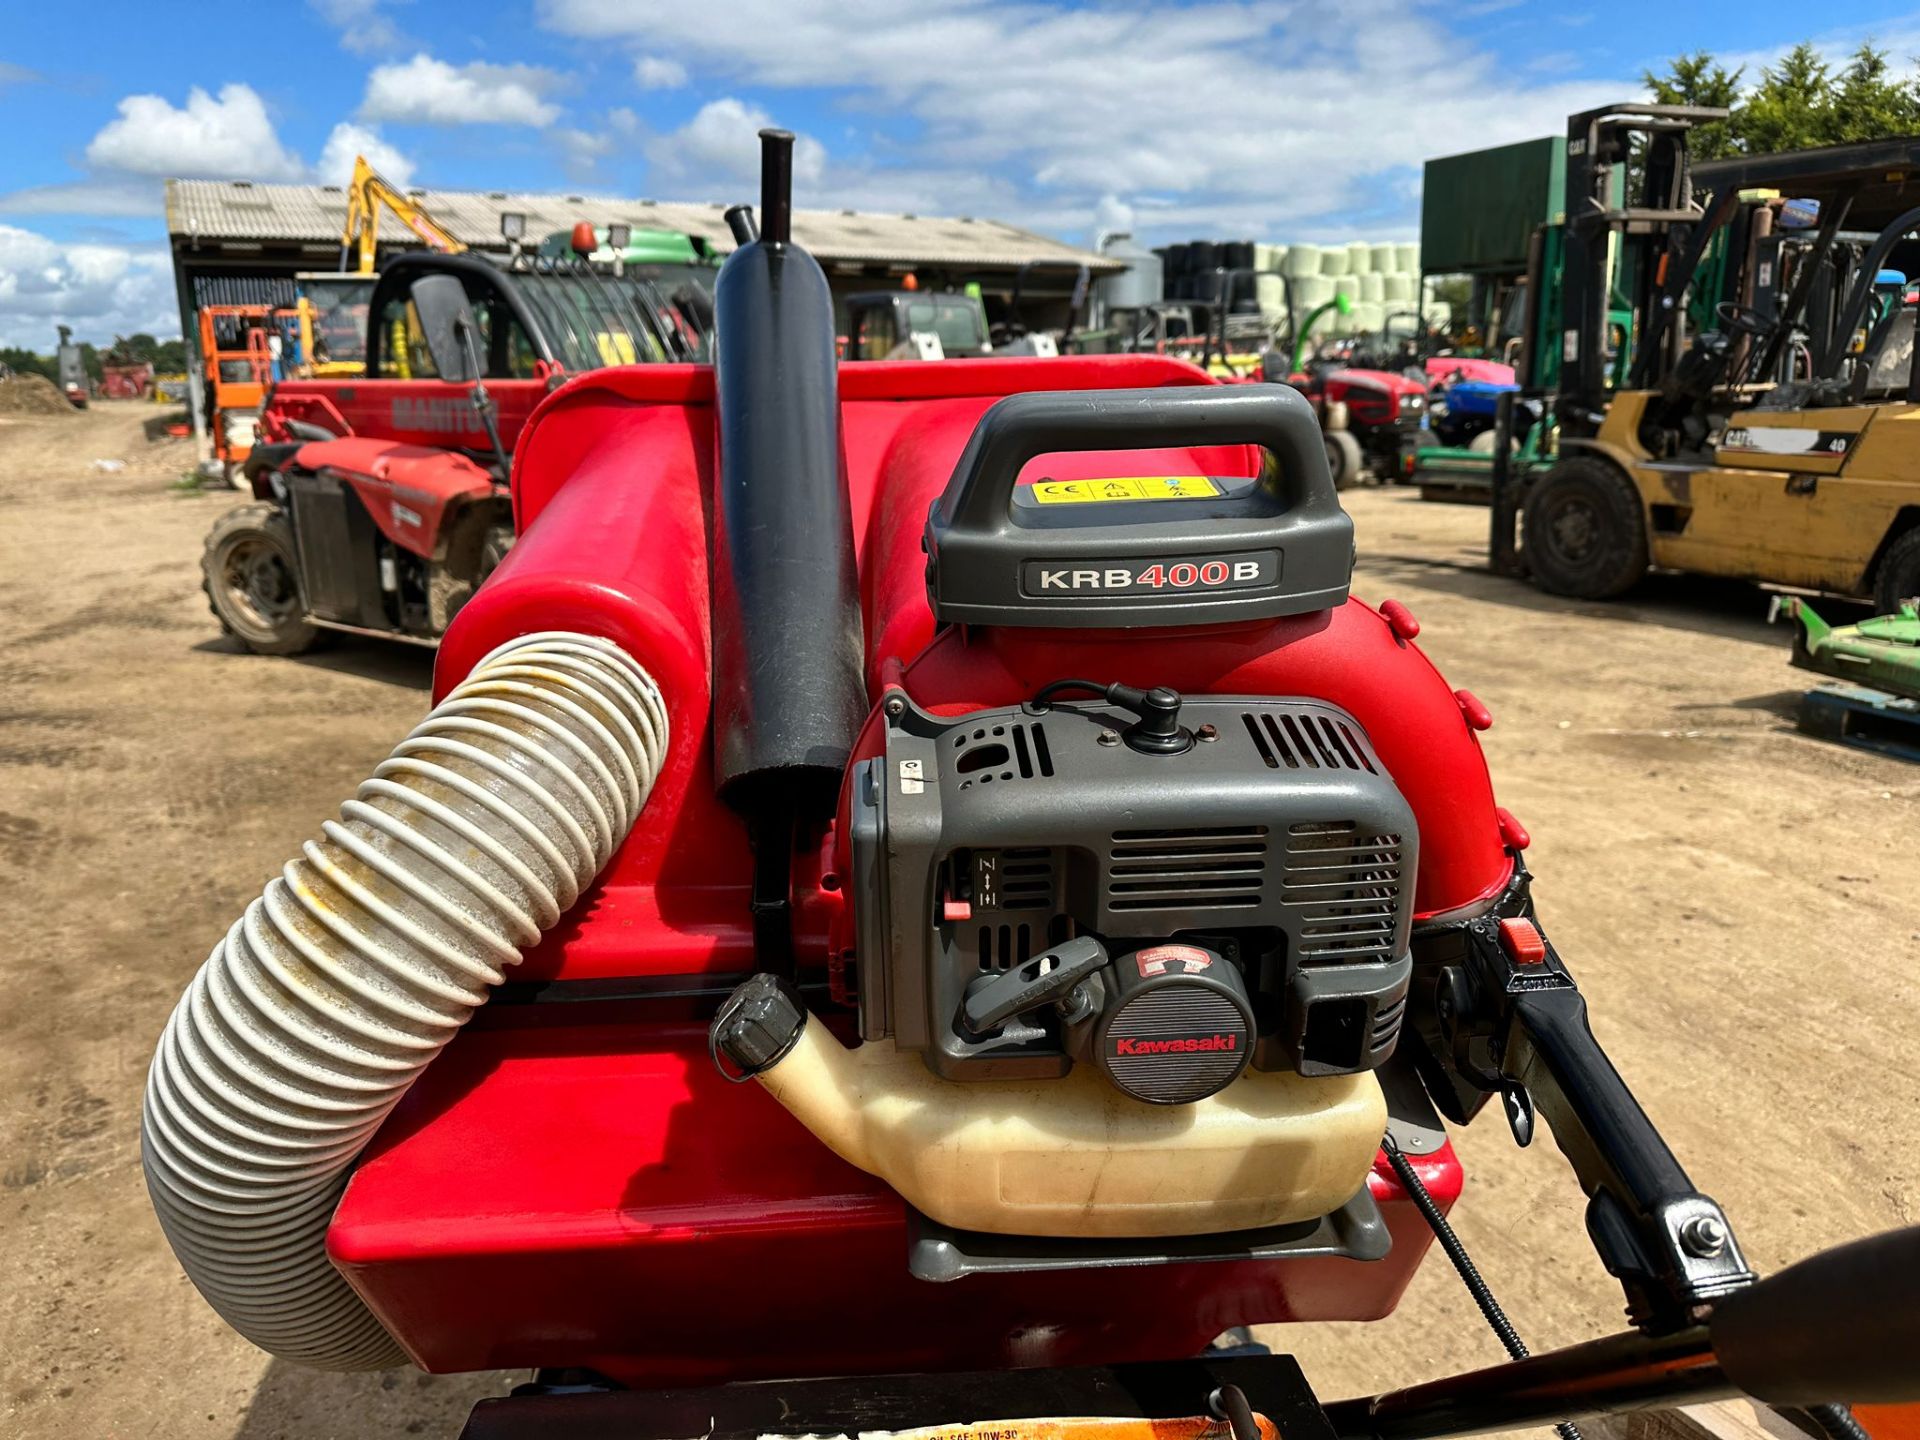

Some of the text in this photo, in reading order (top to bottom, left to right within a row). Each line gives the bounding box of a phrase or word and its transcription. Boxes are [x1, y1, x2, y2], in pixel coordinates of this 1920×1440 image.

[1828, 438, 1847, 454] 40
[1041, 561, 1260, 589] KRB400B
[1117, 1034, 1236, 1056] Kawasaki
[977, 1429, 1018, 1440] 10W-30
